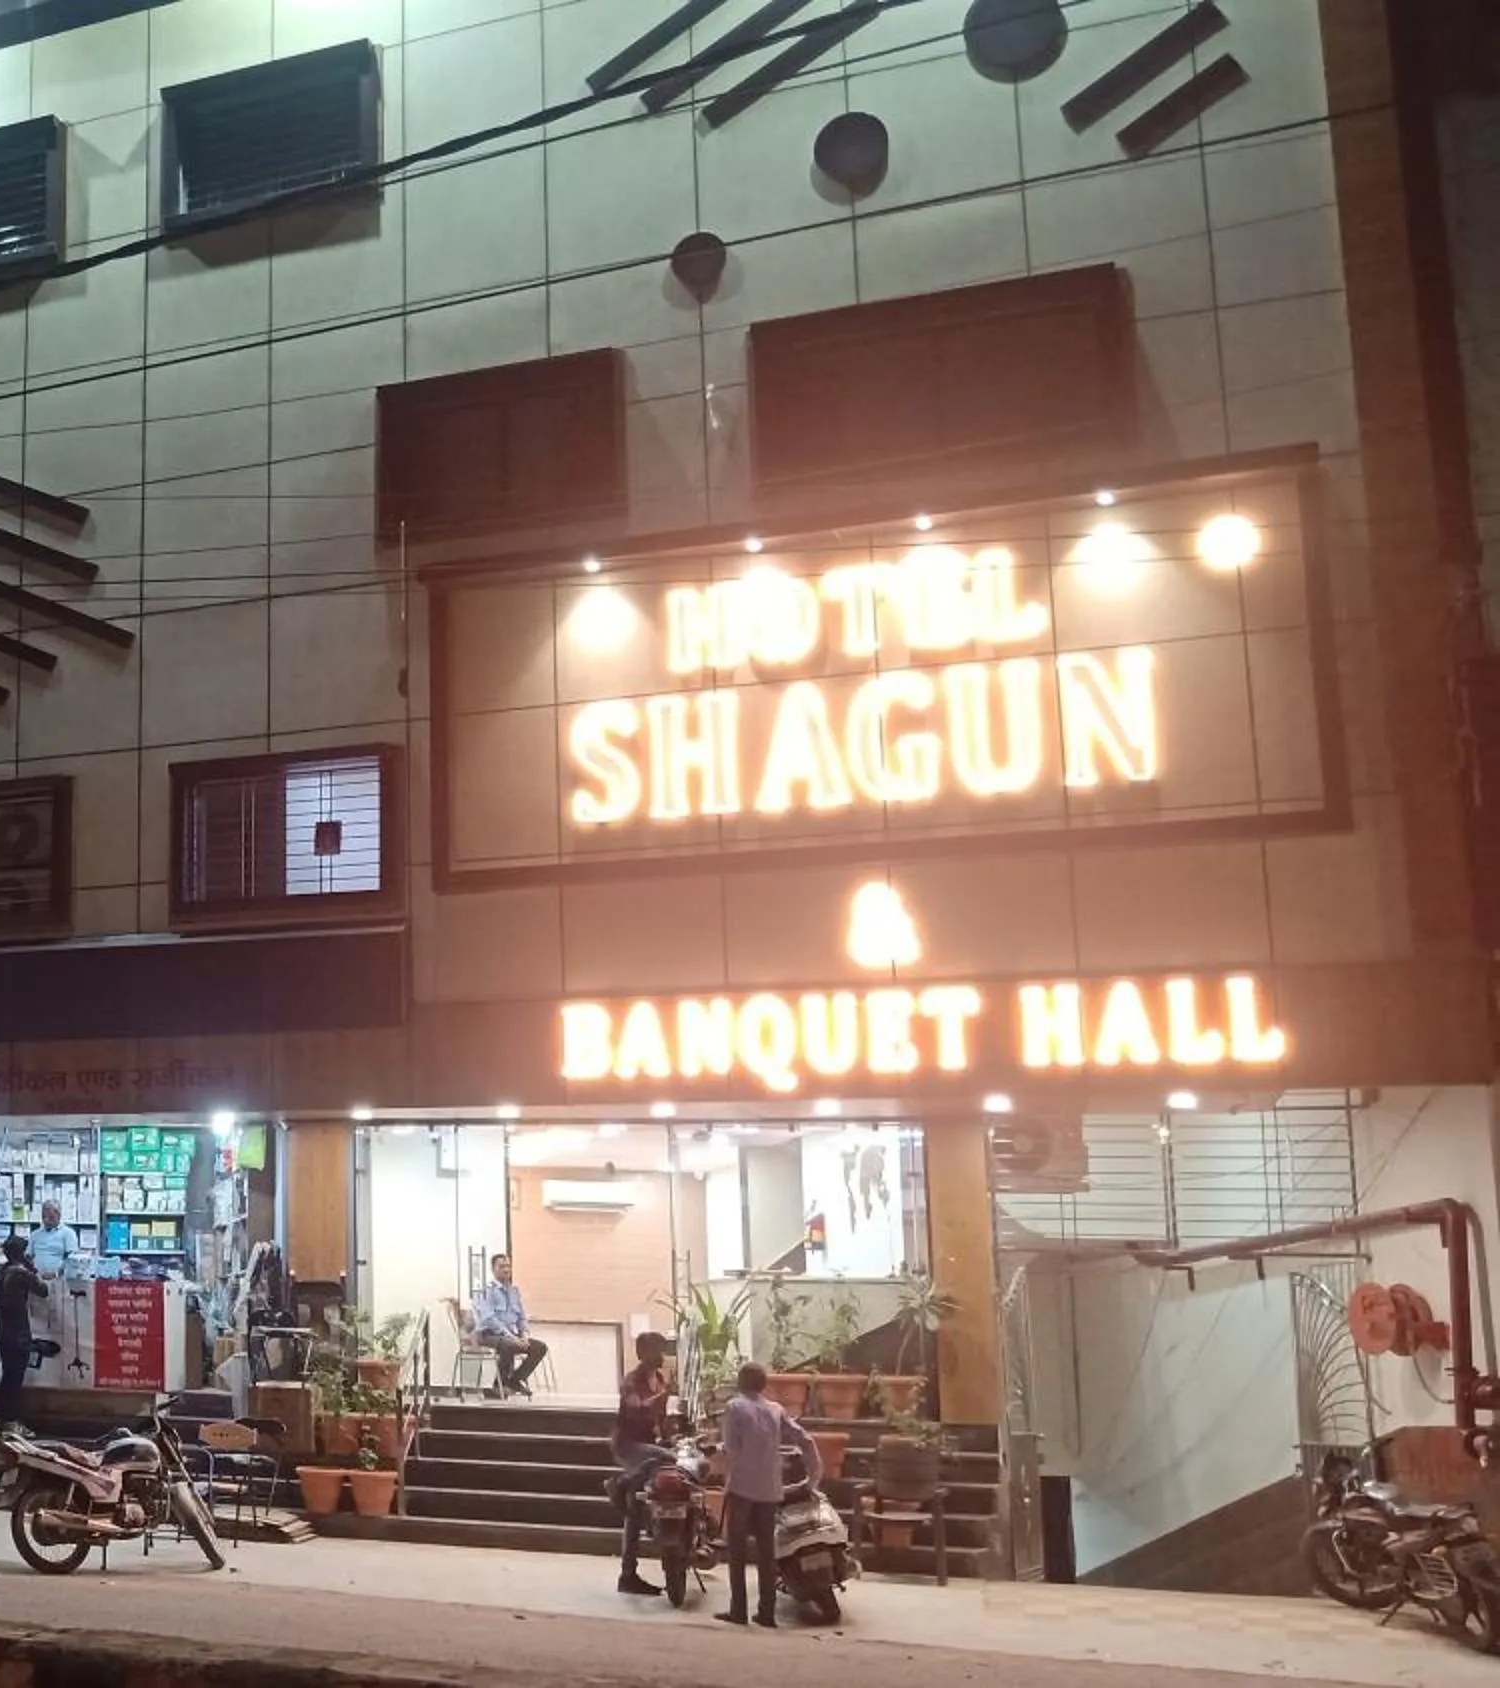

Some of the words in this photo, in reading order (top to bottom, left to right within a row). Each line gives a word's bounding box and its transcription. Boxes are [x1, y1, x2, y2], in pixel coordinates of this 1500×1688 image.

[664, 545, 1050, 674] HOTEL
[569, 646, 1157, 825] SHAGUN
[560, 984, 981, 1091] BANQUET
[1019, 976, 1286, 1068] HALL
